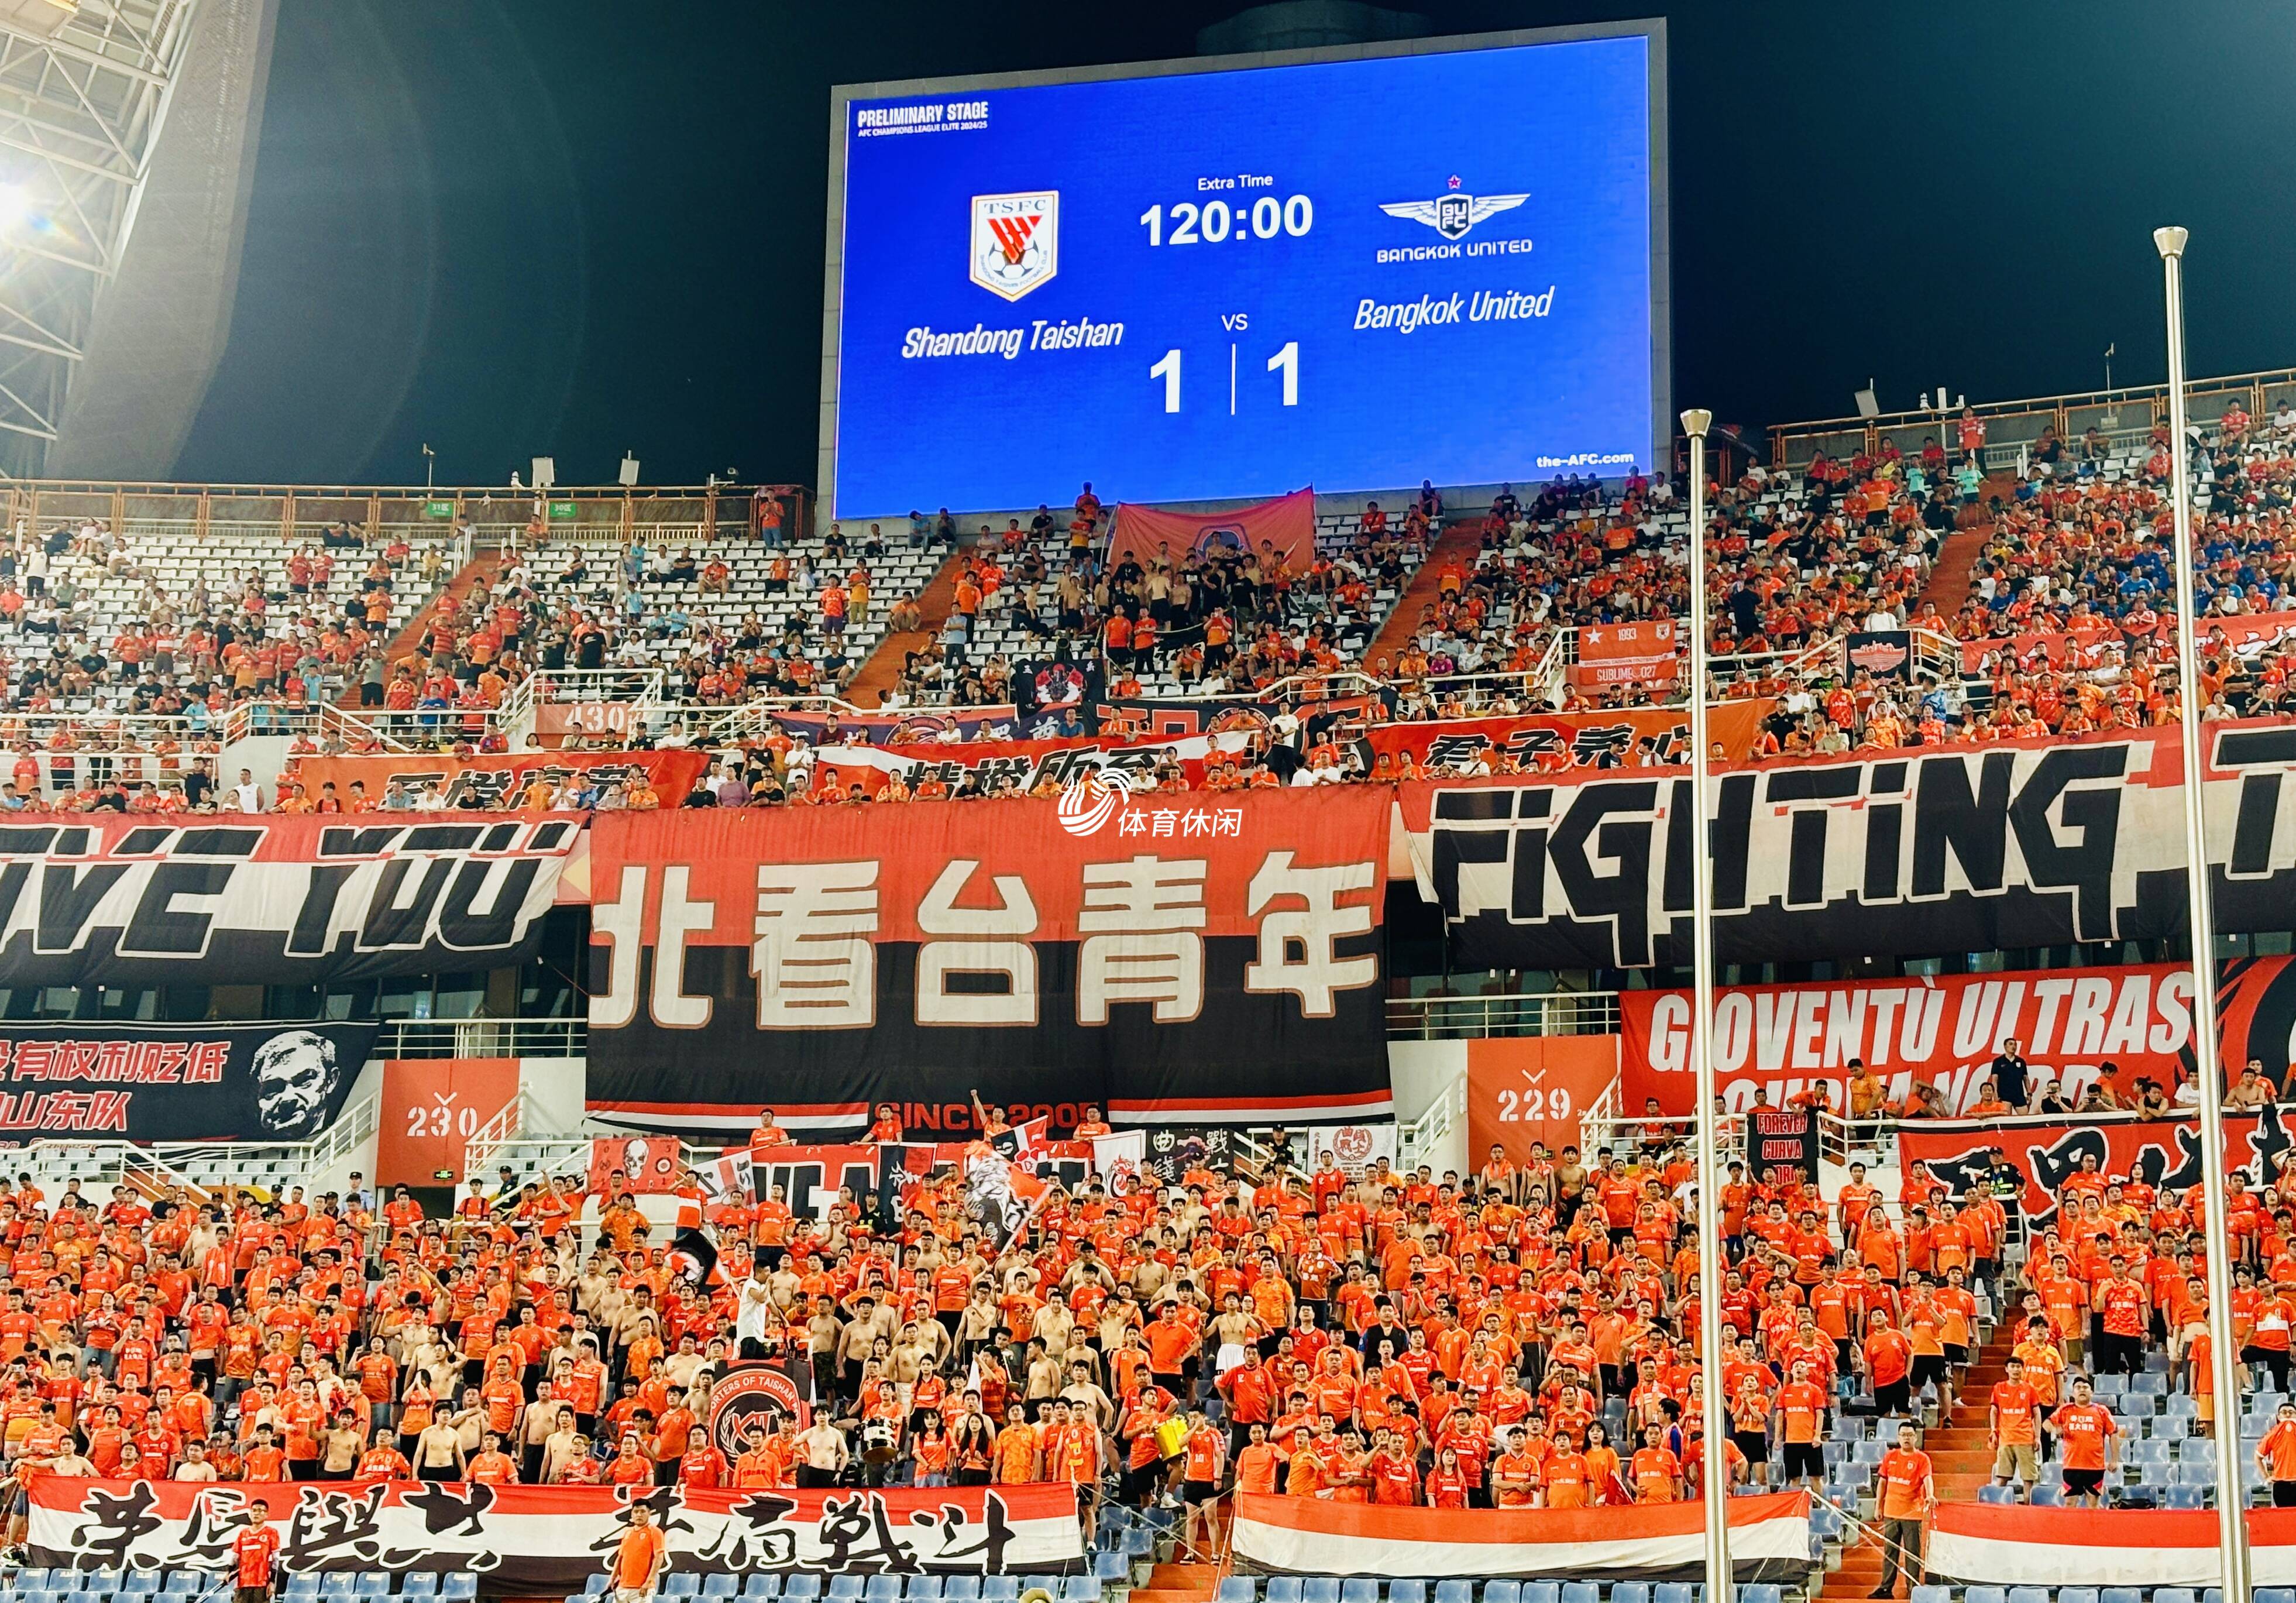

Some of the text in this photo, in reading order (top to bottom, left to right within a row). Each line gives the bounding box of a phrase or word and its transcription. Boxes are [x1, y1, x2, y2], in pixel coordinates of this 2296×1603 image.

[858, 101, 988, 128] PRELIMINARY STAGE
[872, 126, 914, 136] CHAMPIONS
[915, 124, 940, 133] LEAGUE
[941, 123, 960, 131] ELITE
[961, 121, 988, 130] 2024/25
[1198, 174, 1273, 191] Extra Time
[984, 199, 1046, 214] TSFC
[1442, 203, 1467, 216] BU
[1140, 194, 1313, 246] 120:00
[1377, 239, 1533, 263] BANGKOK UNITED
[1353, 285, 1556, 334] Bangkok United
[902, 317, 1124, 360] Shandong Taishan
[1150, 341, 1298, 413] 1 1
[1536, 453, 1634, 468] the-AFC.com
[565, 706, 625, 732] 430
[587, 849, 1379, 1030] 北看台青年
[1953, 972, 2195, 1058] ULTRAS
[1498, 1088, 1570, 1121] 229
[407, 1107, 477, 1137] 230
[1757, 1114, 1807, 1134] FOREVER
[1762, 1139, 1803, 1160] CURVA
[743, 1377, 755, 1386] OF
[758, 1377, 795, 1402] TAISHAN
